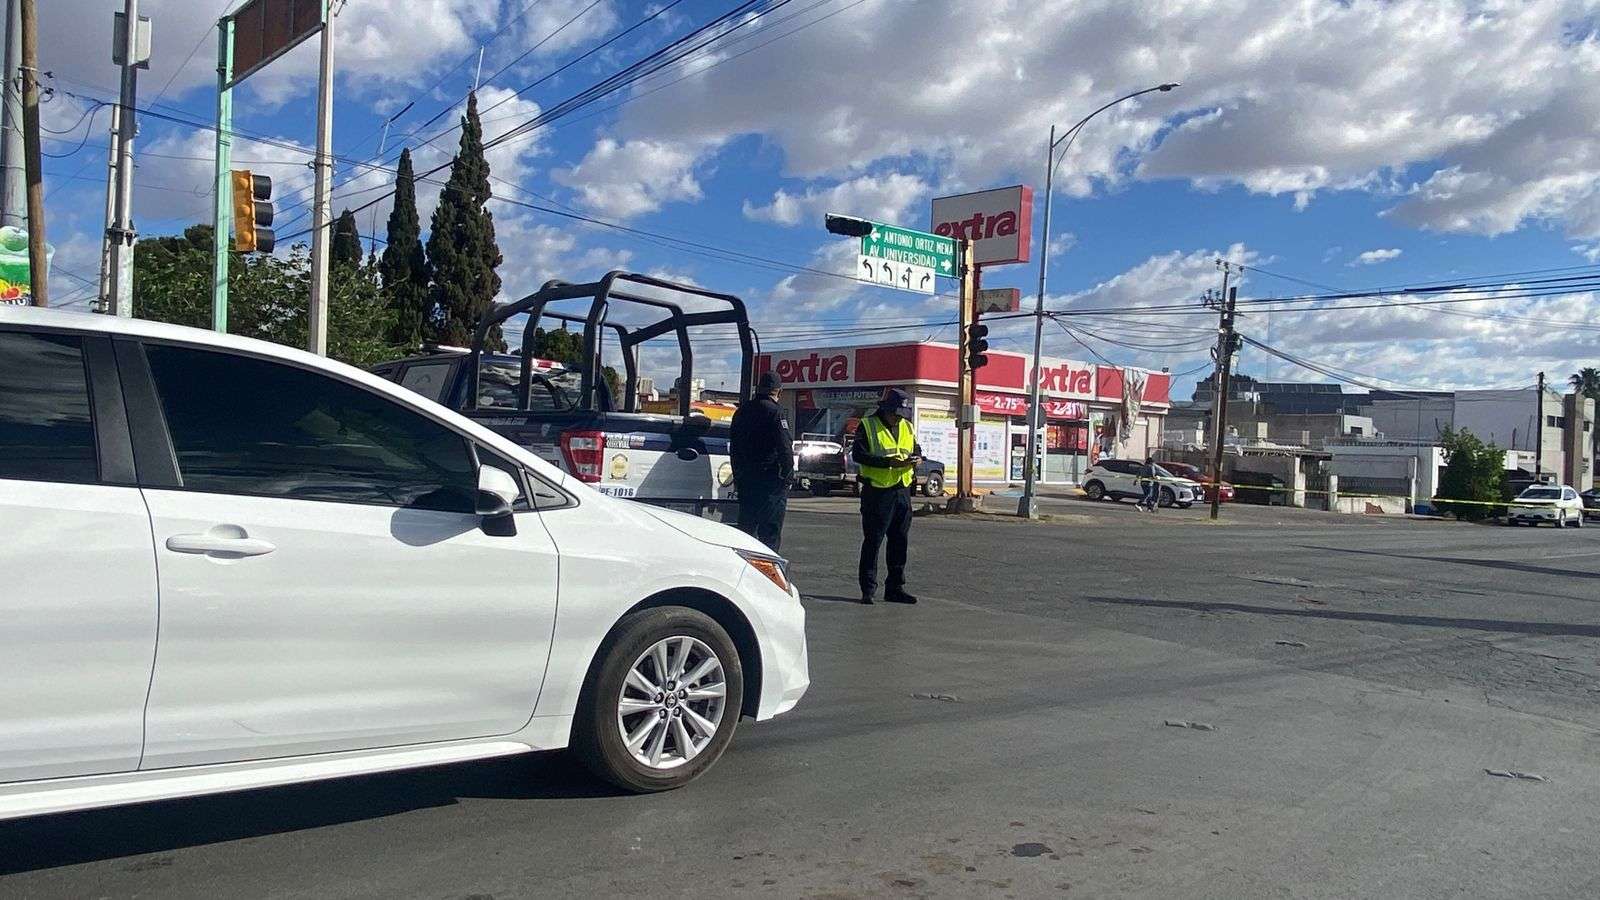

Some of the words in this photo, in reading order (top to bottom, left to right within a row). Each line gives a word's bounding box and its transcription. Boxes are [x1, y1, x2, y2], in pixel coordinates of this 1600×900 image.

[935, 211, 1017, 240] extra
[884, 233, 913, 248] ANTONIO
[915, 239, 935, 252] ORTIZ
[936, 243, 953, 255] MENA
[869, 246, 879, 257] AV
[884, 248, 937, 268] UNIVERSIDAD
[777, 353, 848, 382] extra
